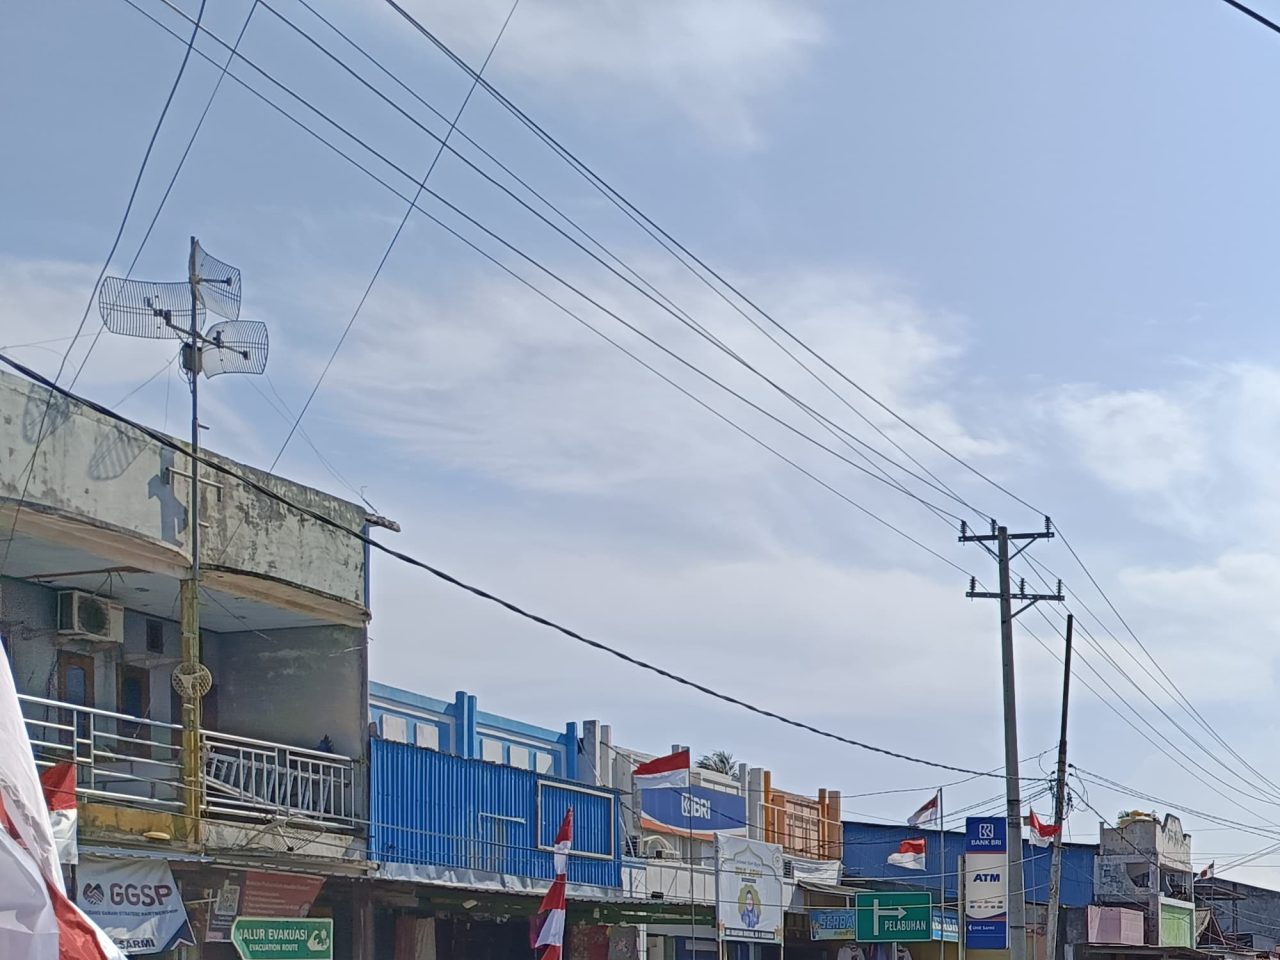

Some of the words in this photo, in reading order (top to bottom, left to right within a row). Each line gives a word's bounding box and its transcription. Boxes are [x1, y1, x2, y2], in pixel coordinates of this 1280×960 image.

[973, 873, 1000, 883] ATM
[109, 882, 173, 907] GGSP
[884, 920, 927, 931] PELABUHAN
[240, 928, 266, 940] JALUR
[268, 928, 308, 941] EVAKUASI
[118, 938, 156, 950] SARMI
[249, 943, 281, 952] EVACUATION
[282, 943, 298, 951] ROUTE
